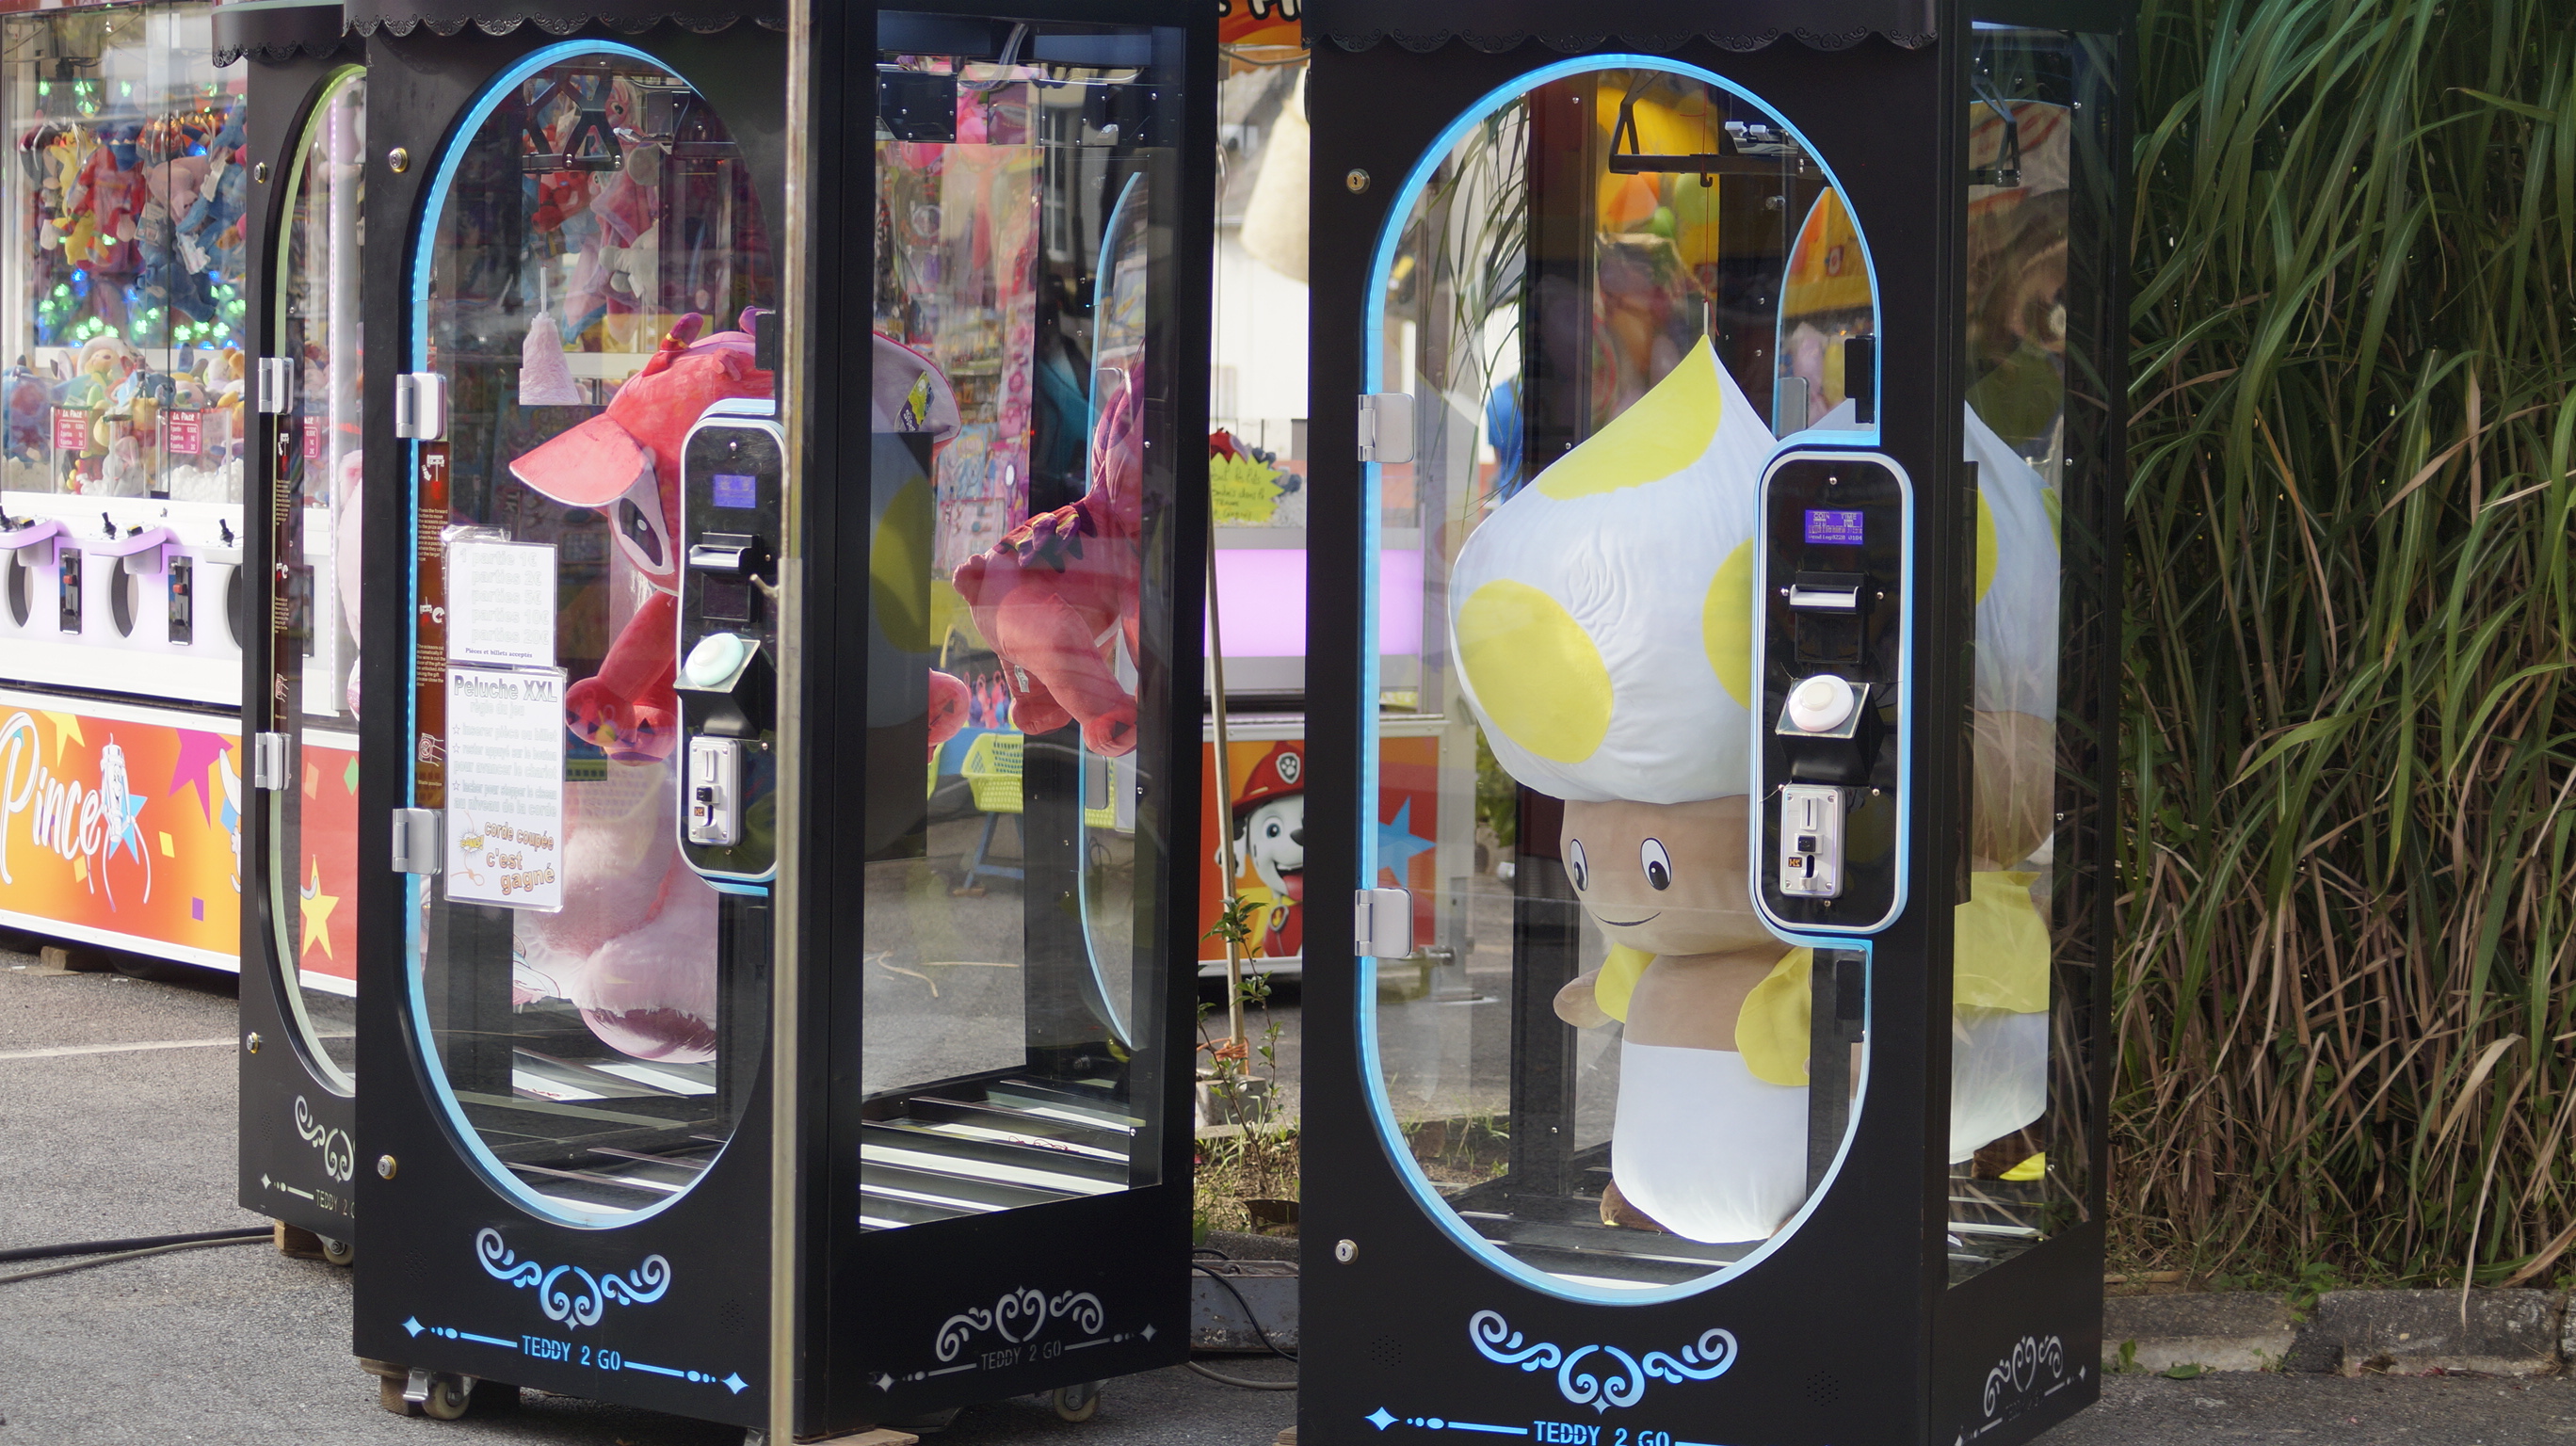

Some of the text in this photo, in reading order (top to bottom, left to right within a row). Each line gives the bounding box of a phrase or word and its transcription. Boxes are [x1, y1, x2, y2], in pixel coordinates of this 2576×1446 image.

[460, 548, 538, 568] 1 partie 1€
[472, 570, 542, 586] parties 2€
[472, 588, 542, 605] parties 5€
[472, 607, 550, 625] parties 10€
[472, 627, 550, 646] parties 20€
[465, 648, 482, 656] Pièces
[454, 674, 557, 703] Peluche XXL
[496, 700, 507, 715] du
[508, 701, 525, 719] jeu
[521, 730, 533, 741] ou
[534, 728, 558, 743] billet
[511, 748, 523, 759] sur
[524, 747, 532, 760] le
[533, 747, 558, 762] bouton
[454, 761, 558, 780] pour avancer le chariot
[0, 711, 103, 886] Pince
[485, 783, 499, 797] pour
[501, 783, 526, 800] stopper
[454, 795, 558, 817] au niveau de la corde
[484, 821, 555, 853] corde coupée
[486, 847, 523, 872] c'est
[500, 862, 555, 896] gagné
[315, 1188, 339, 1213] TEDDY
[343, 1197, 348, 1216] 2
[522, 1334, 621, 1371] TEDDY 2 GO
[981, 1340, 1062, 1372] TEDDY 2 GO
[1533, 1420, 1671, 1446] TEDDY 2 GO
